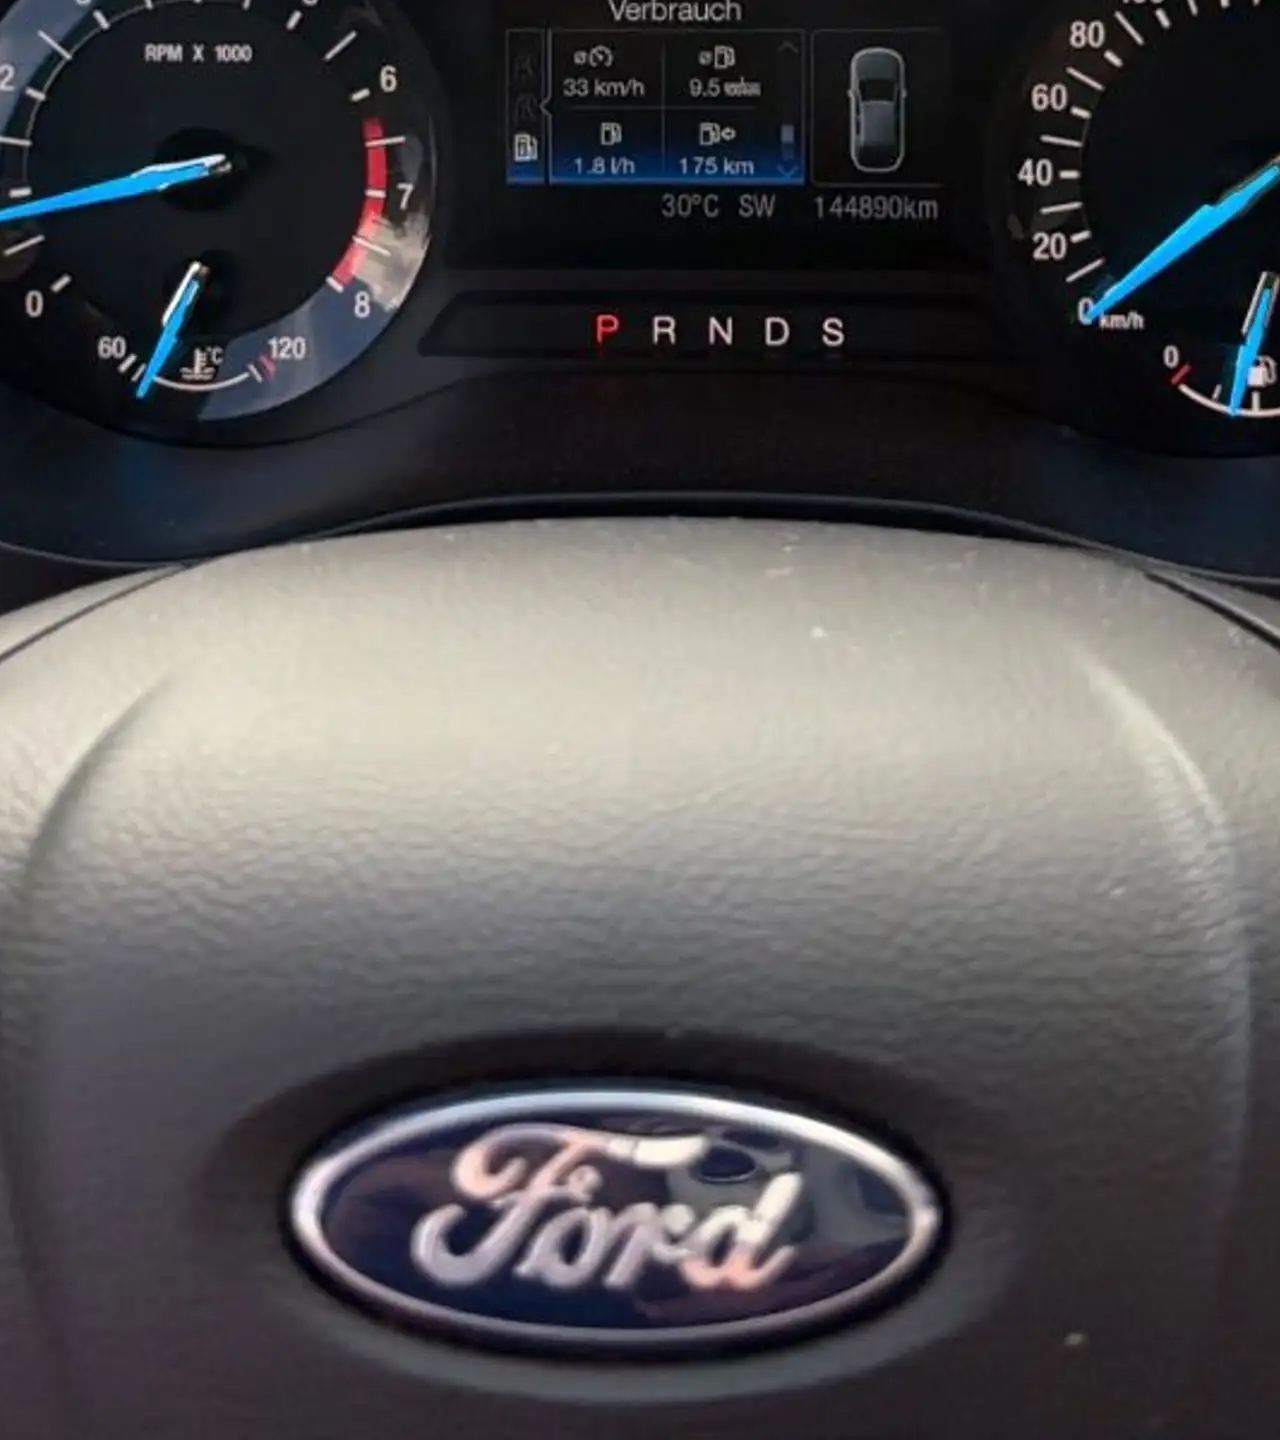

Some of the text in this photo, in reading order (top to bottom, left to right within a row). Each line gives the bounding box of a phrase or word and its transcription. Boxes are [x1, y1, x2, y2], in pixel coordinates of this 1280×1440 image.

[1068, 21, 1106, 49] 80
[144, 44, 253, 62] RPM X 1000
[379, 66, 398, 92] 6
[562, 78, 646, 99] 33 km/h
[689, 78, 721, 100] 9.5
[1031, 83, 1068, 111] 60
[573, 157, 603, 177] 1.8
[679, 157, 756, 178] 175 km
[1018, 158, 1053, 187] 40
[396, 184, 415, 210] 7
[660, 193, 777, 219] 30°C SW
[1032, 232, 1067, 261] 20
[24, 289, 44, 318] 0
[353, 291, 371, 318] 8
[595, 315, 846, 347] P R N D S
[98, 335, 127, 359] 60
[269, 338, 306, 361] 120
[1163, 346, 1179, 368] 0
[409, 1121, 804, 1290] Ford
